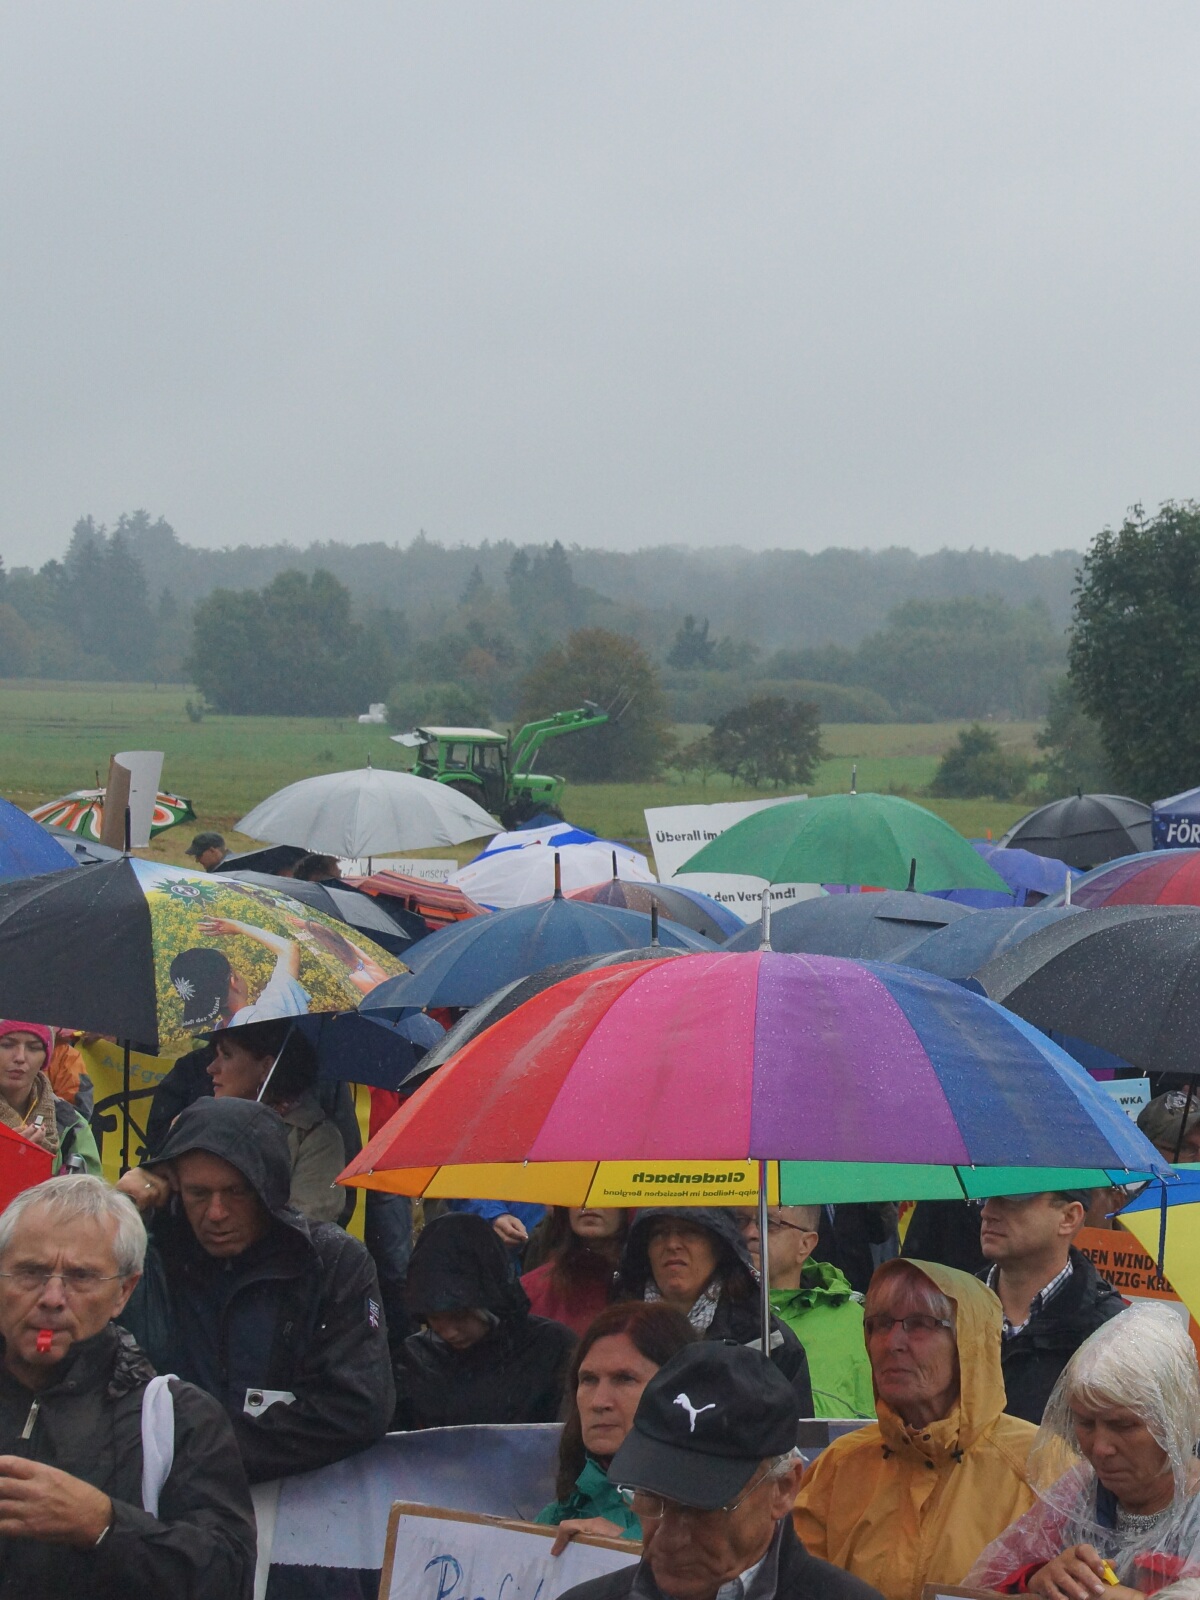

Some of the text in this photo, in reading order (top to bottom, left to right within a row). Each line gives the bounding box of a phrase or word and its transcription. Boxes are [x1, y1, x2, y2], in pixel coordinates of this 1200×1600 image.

[655, 829, 718, 843] Überall im
[714, 887, 797, 902] den Versand!
[1120, 1096, 1143, 1105] WKA
